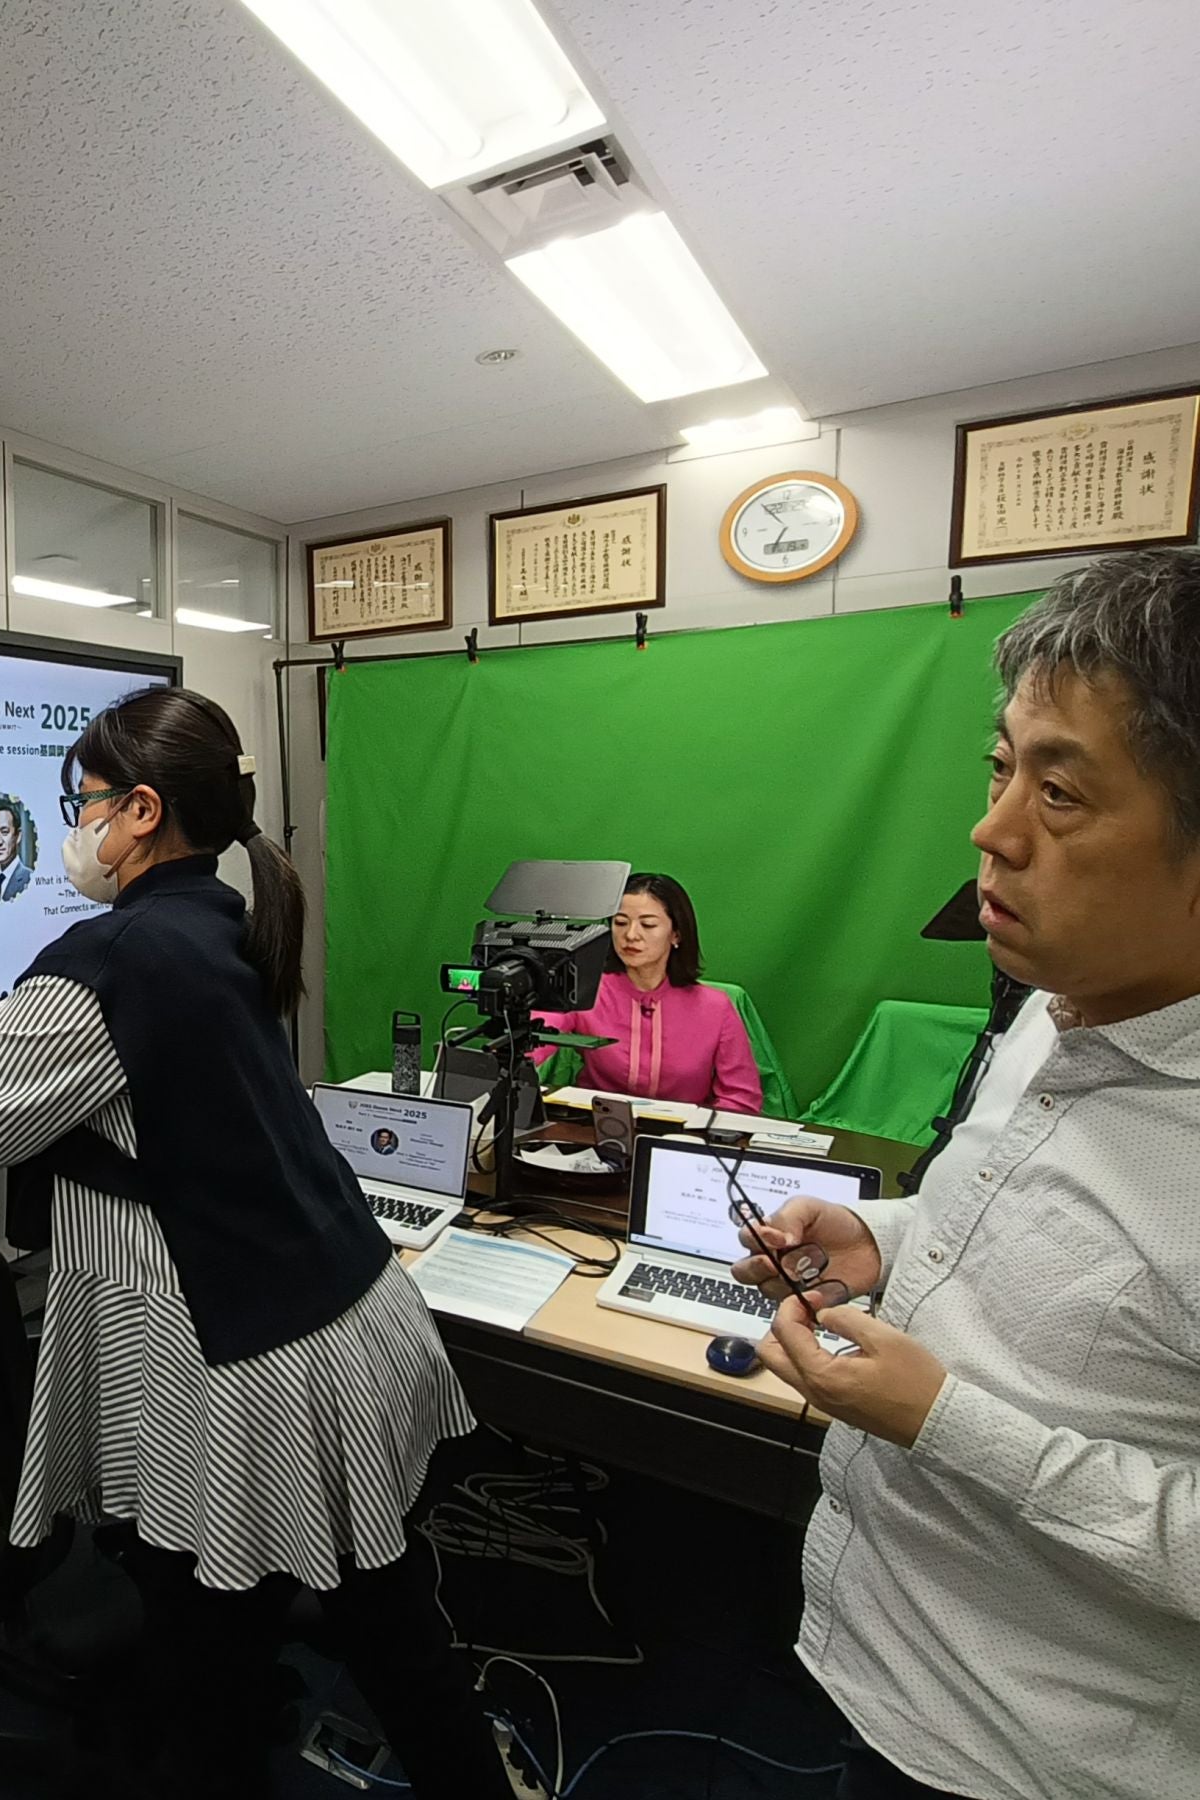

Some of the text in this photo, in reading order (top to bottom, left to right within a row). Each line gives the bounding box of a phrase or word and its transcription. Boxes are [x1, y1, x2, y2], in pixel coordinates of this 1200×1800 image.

[1139, 450, 1157, 496] 感謝状
[5, 701, 35, 720] Next
[40, 703, 91, 732] 2025
[35, 875, 54, 886] What
[56, 874, 62, 884] is
[44, 907, 58, 917] That
[60, 903, 89, 914] Connects
[404, 1109, 427, 1119] 2025
[770, 1175, 801, 1189] 2025
